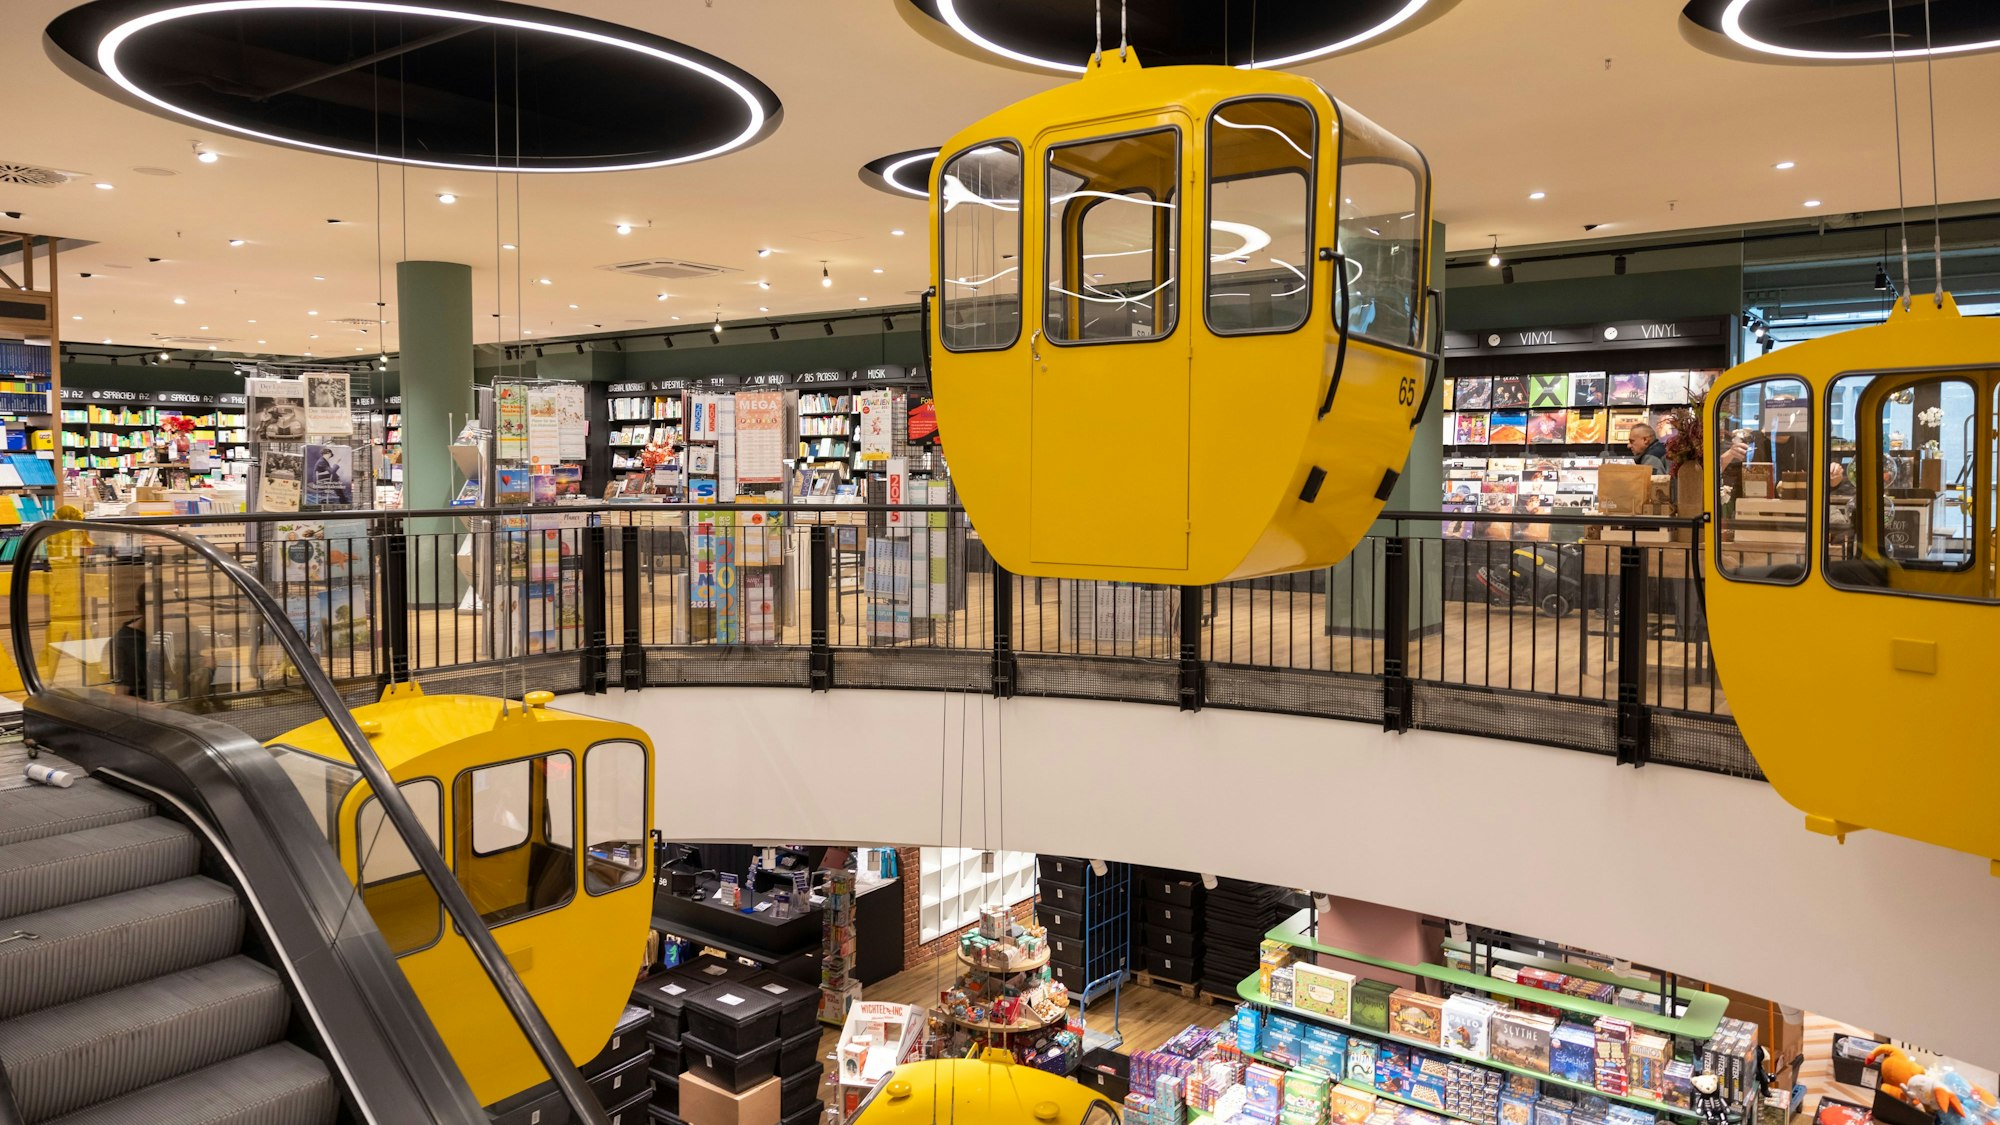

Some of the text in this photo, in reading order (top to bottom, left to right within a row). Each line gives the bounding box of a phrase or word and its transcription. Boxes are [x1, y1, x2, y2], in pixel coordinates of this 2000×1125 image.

[1641, 323, 1682, 339] VINYL
[1519, 330, 1557, 346] VINYL
[804, 371, 839, 383] BIS PICASSO
[867, 368, 886, 379] MUSIK
[661, 380, 684, 390] LIFESTYLE
[711, 377, 724, 387] FILM
[102, 390, 136, 401] SPRACHEN
[1398, 376, 1416, 407] 65
[170, 393, 200, 403] SPRACHEN
[740, 399, 778, 410] MEGA
[860, 1004, 885, 1015] WICHTEL
[1449, 1013, 1479, 1028] PALEO
[1503, 1023, 1538, 1041] SCYTHE
